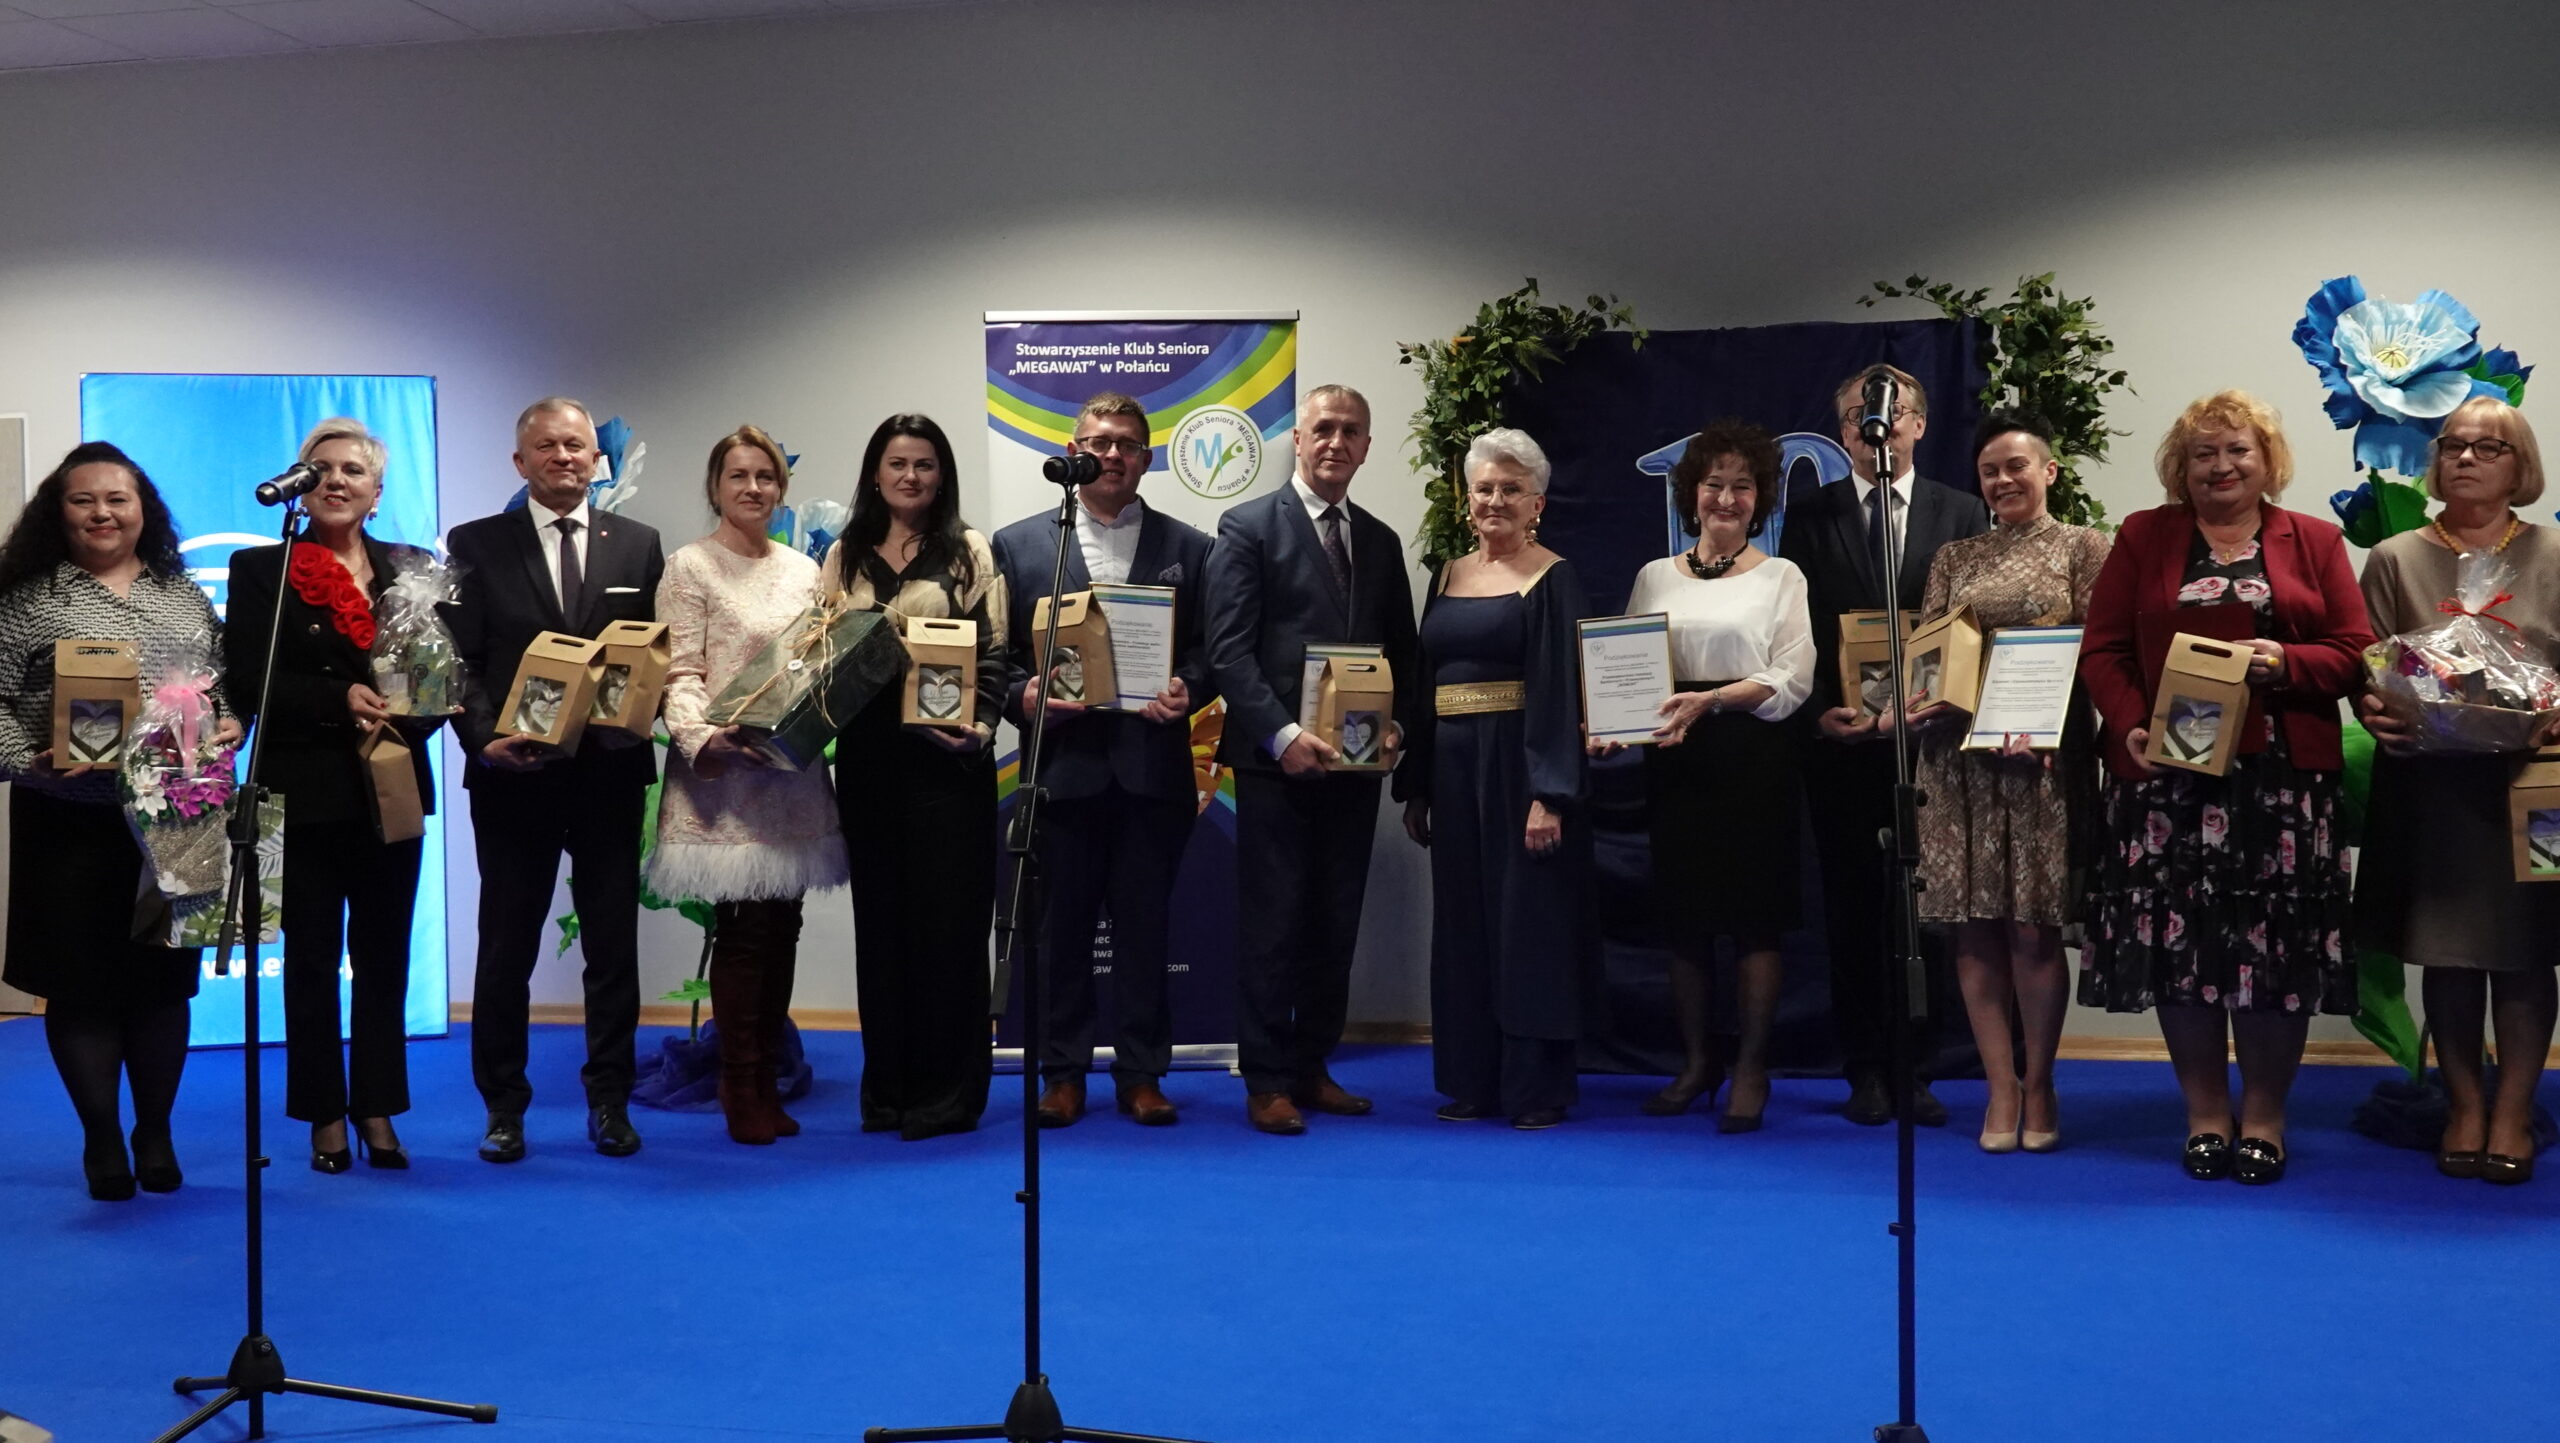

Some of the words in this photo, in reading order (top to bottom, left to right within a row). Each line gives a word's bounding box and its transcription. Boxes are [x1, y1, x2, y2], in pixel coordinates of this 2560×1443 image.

[1016, 342, 1120, 358] Stowarzyszenie
[1124, 342, 1155, 355] Klub
[1158, 342, 1210, 355] Seniora
[1008, 360, 1096, 376] „MEGAWAT”
[1100, 363, 1112, 373] w
[1116, 359, 1170, 373] Połańcu
[1187, 420, 1204, 434] Klub
[1205, 416, 1234, 426] Seniora
[1180, 434, 1203, 489] Stowarzyszenie
